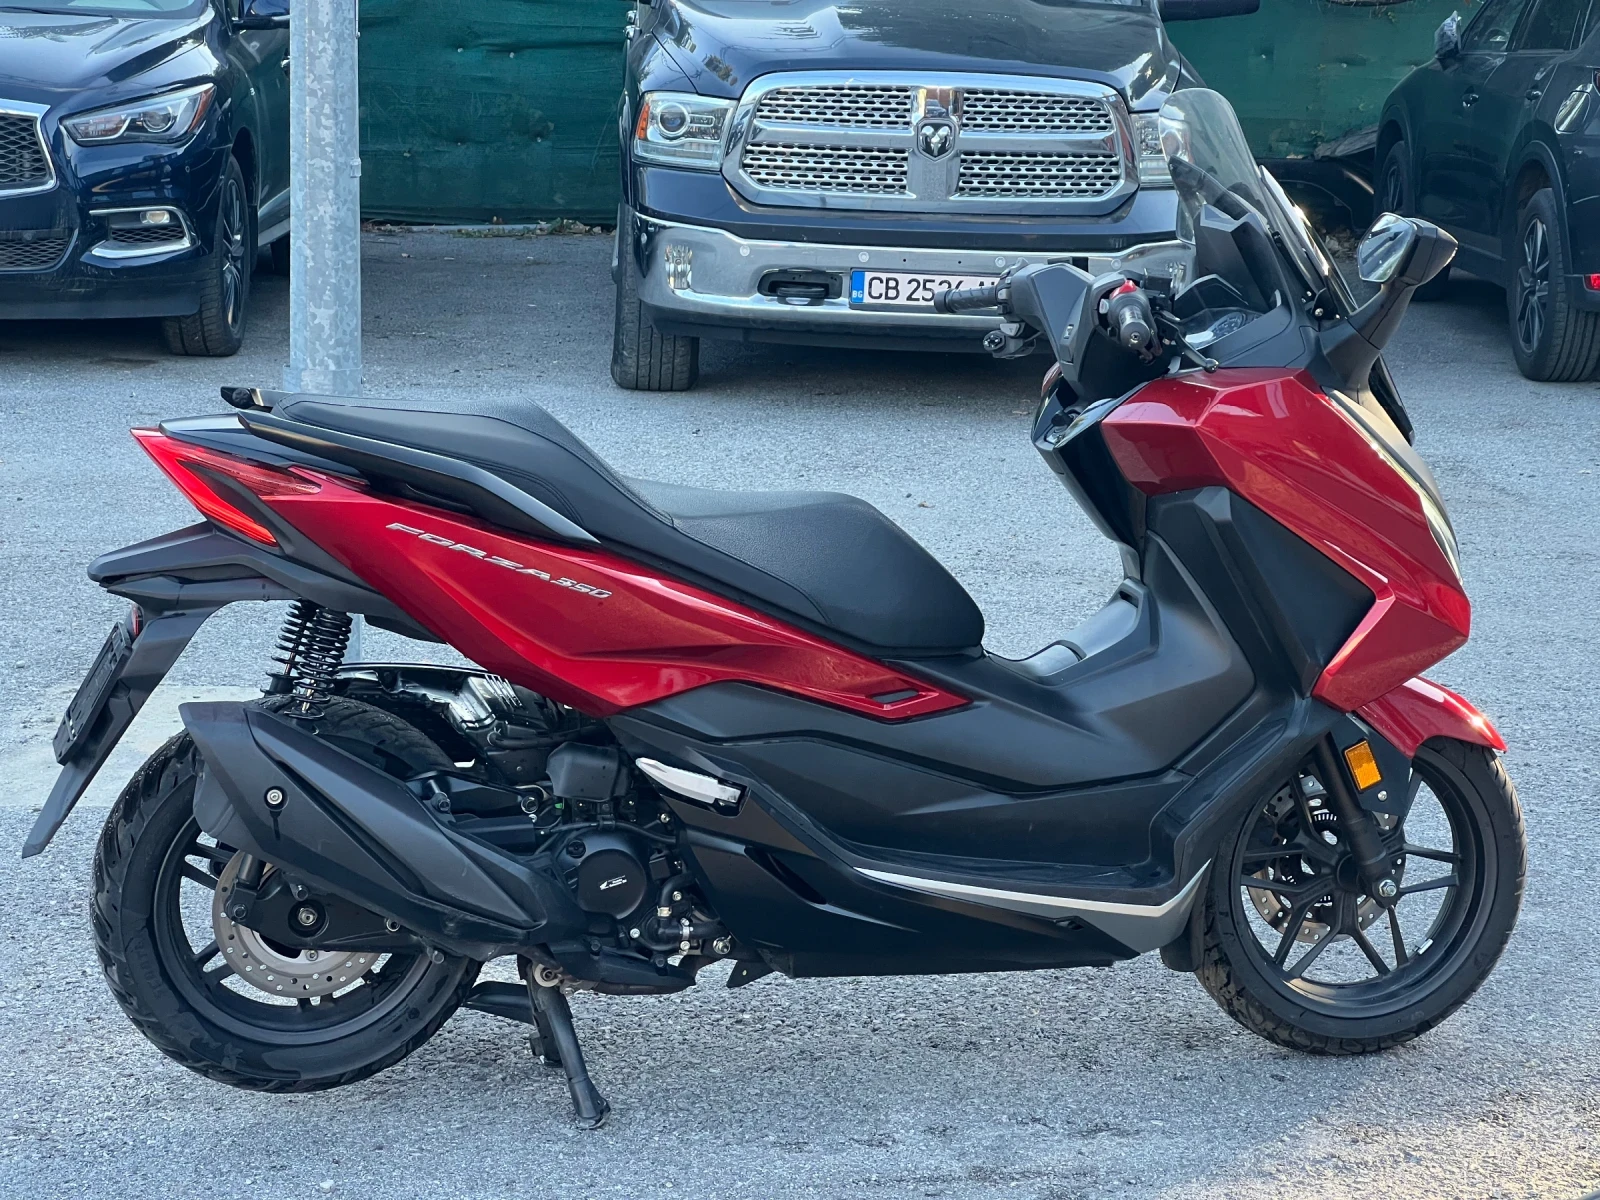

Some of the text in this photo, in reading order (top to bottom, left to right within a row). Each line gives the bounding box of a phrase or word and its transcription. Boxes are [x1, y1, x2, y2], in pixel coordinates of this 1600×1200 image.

[852, 290, 863, 298] BG
[867, 276, 900, 301] CB
[385, 522, 613, 599] FORZA 350
